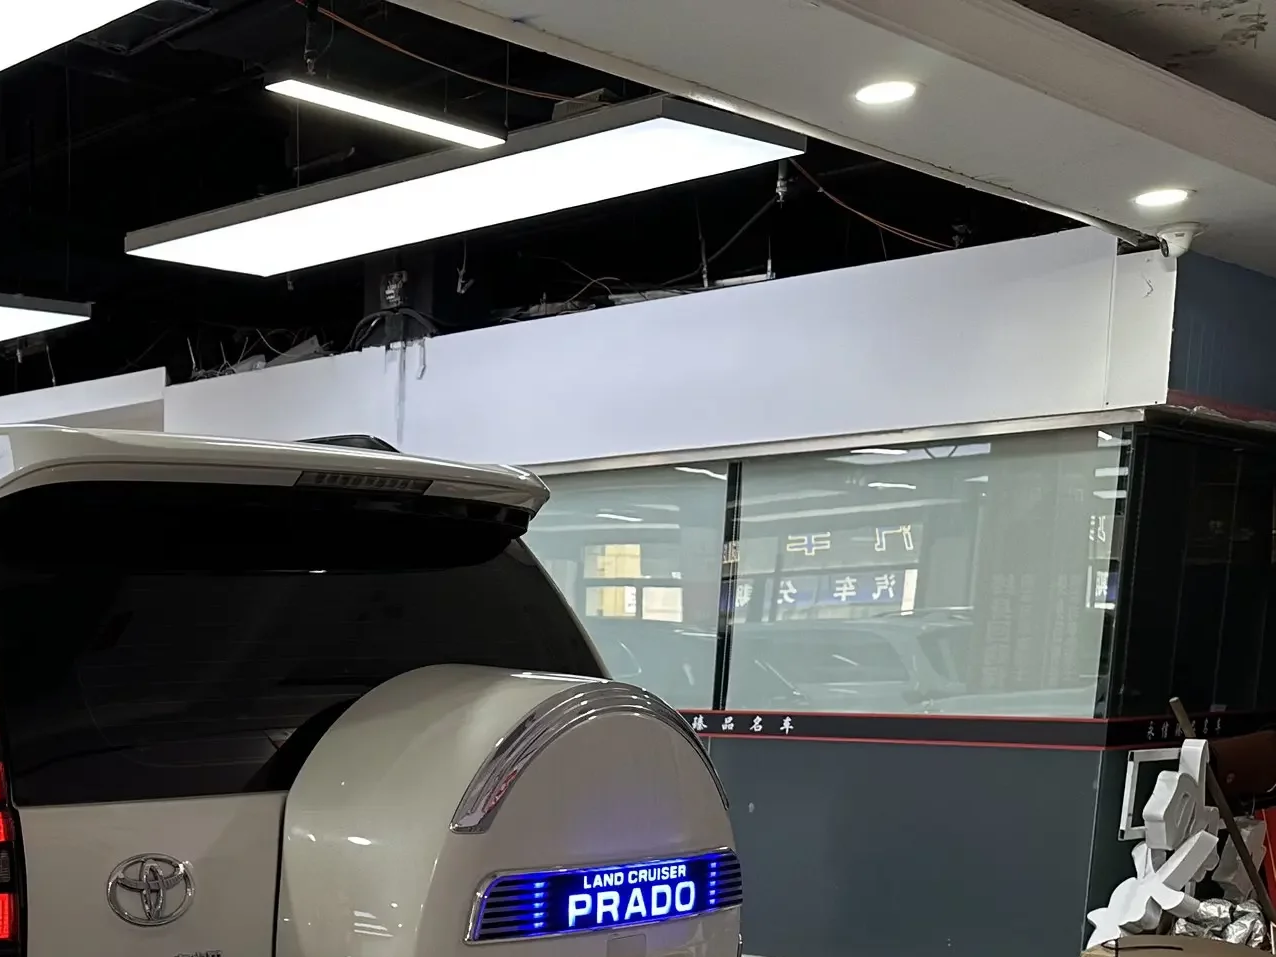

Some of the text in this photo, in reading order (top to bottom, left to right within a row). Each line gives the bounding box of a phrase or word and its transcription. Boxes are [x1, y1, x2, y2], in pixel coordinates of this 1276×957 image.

[583, 864, 687, 889] LAND CRUISER
[568, 881, 696, 927] PRADO
